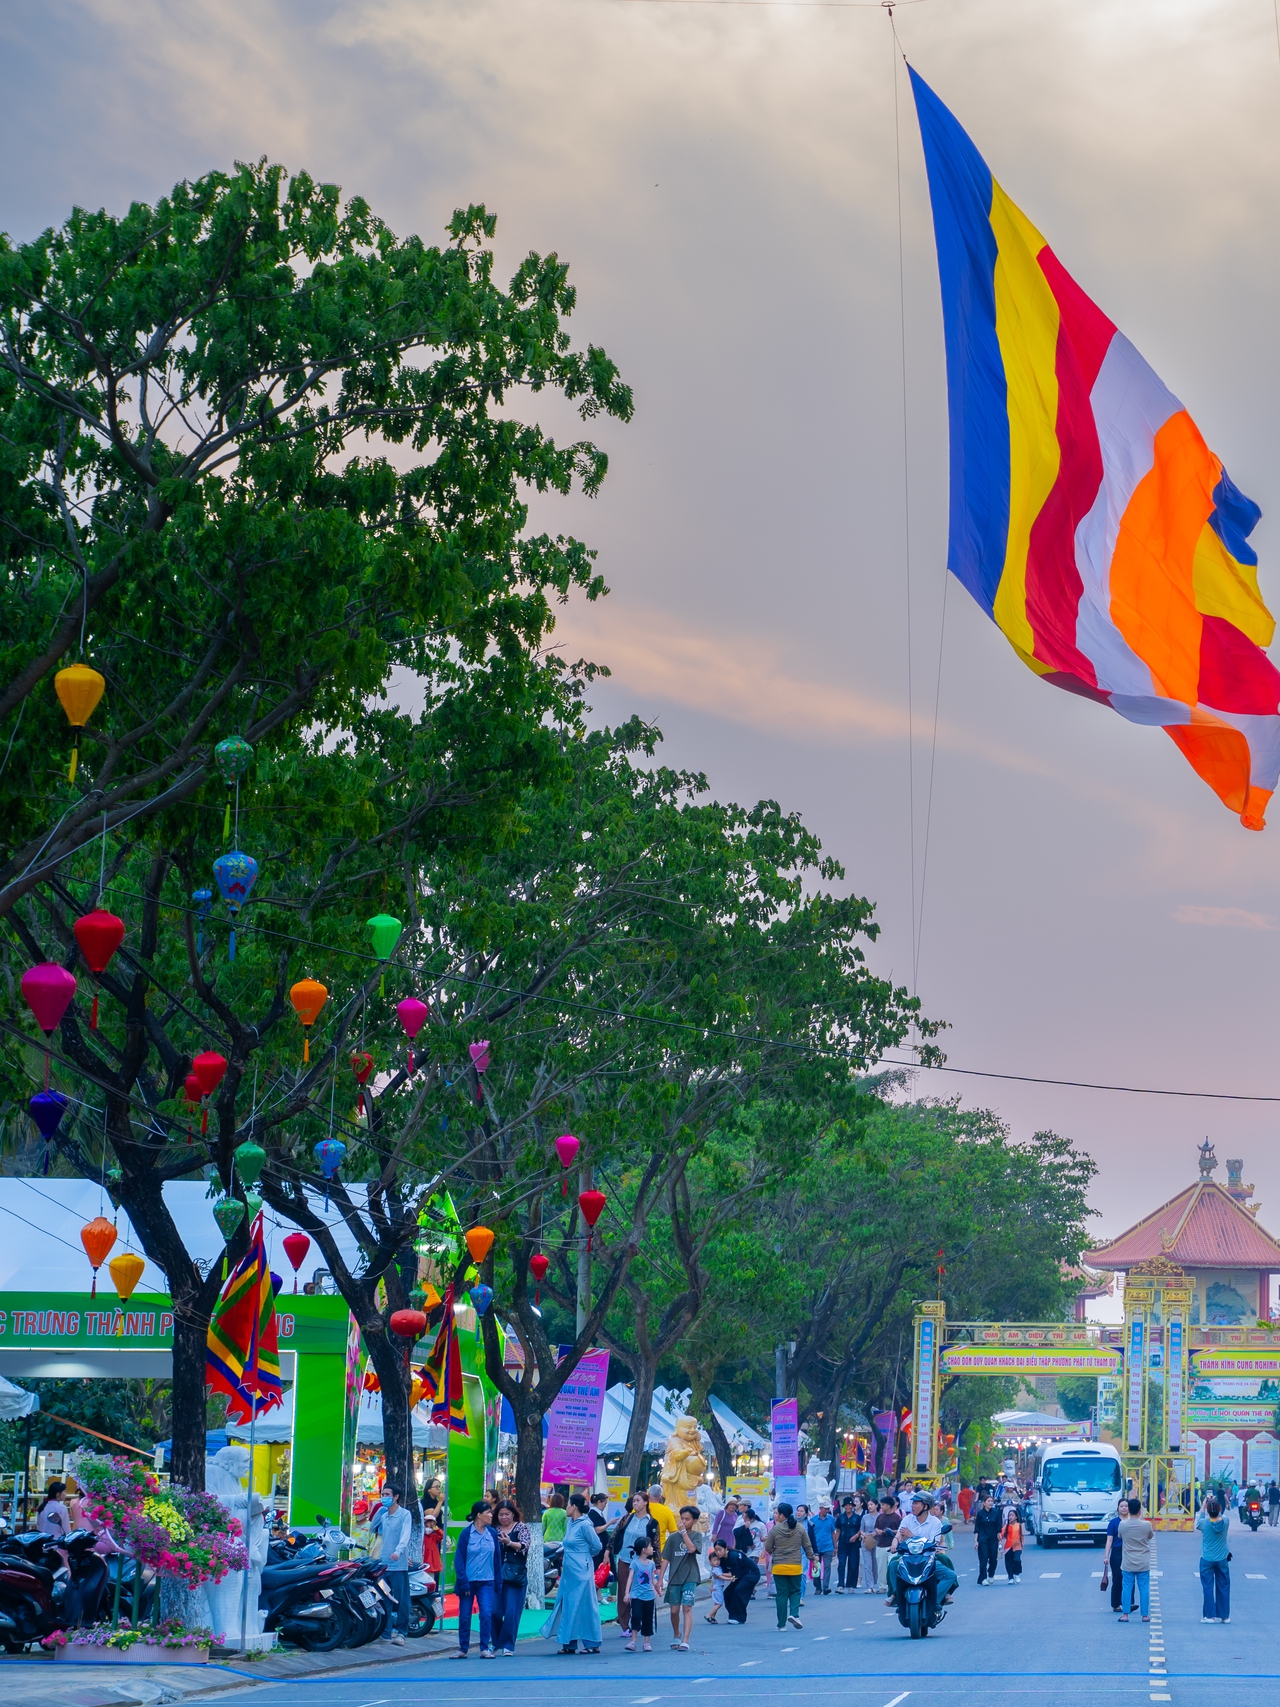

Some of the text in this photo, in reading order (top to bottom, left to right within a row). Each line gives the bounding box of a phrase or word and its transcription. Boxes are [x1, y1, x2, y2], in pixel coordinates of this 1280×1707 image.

[12, 1310, 80, 1336] TRƯNG
[86, 1307, 152, 1337] THÀNH
[947, 1355, 960, 1366] CHÀO
[984, 1357, 997, 1366] QUAN
[999, 1355, 1014, 1366] KHÁCH
[1094, 1358, 1108, 1366] THAM
[1200, 1358, 1218, 1369] THÀNH
[1221, 1359, 1234, 1369] KÍNH
[1237, 1360, 1252, 1369] CUNG
[1255, 1361, 1277, 1369] NGHINH
